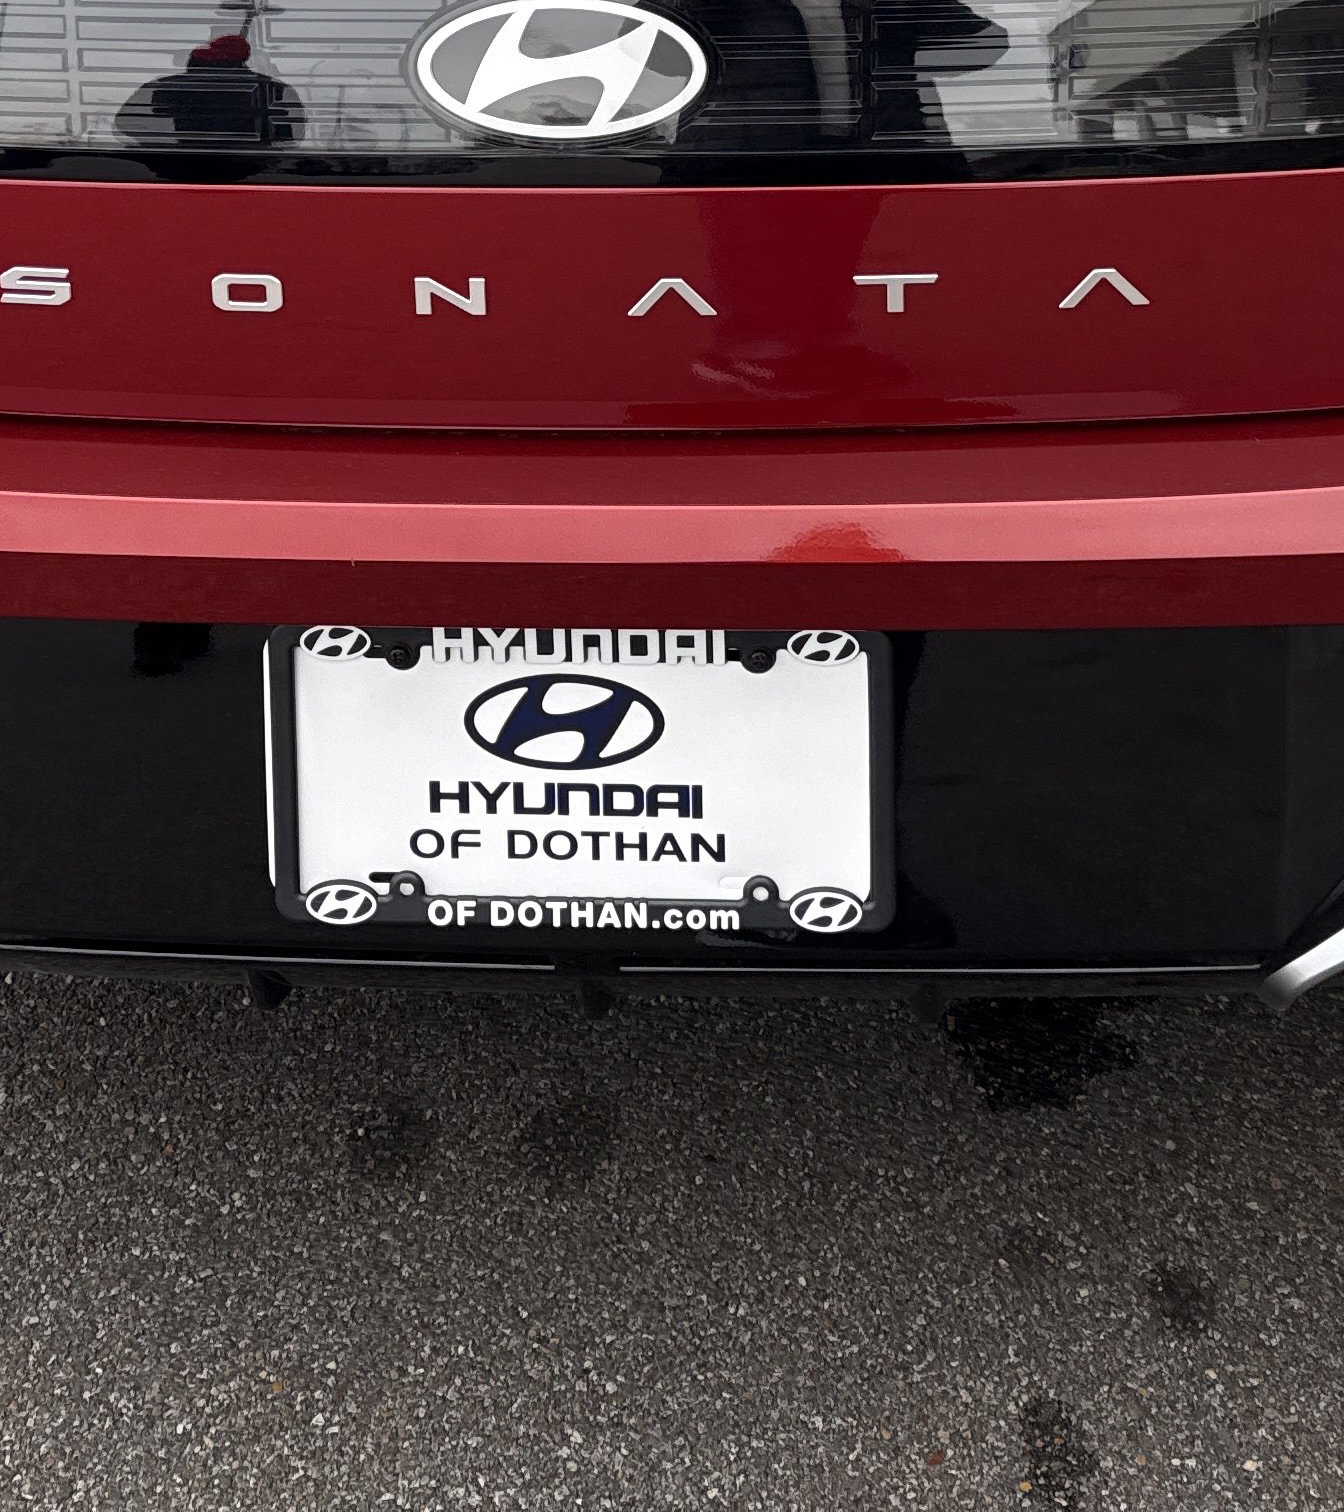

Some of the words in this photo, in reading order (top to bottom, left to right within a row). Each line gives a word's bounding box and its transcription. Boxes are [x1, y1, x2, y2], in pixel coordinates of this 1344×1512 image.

[0, 266, 1150, 316] SONATA
[430, 627, 726, 664] HYUNDAI
[429, 781, 704, 818] HYUNDAI
[409, 829, 481, 859] OF
[508, 829, 726, 862] DOTHAN
[427, 899, 476, 926] OF
[490, 900, 740, 930] DOTHAN.com
